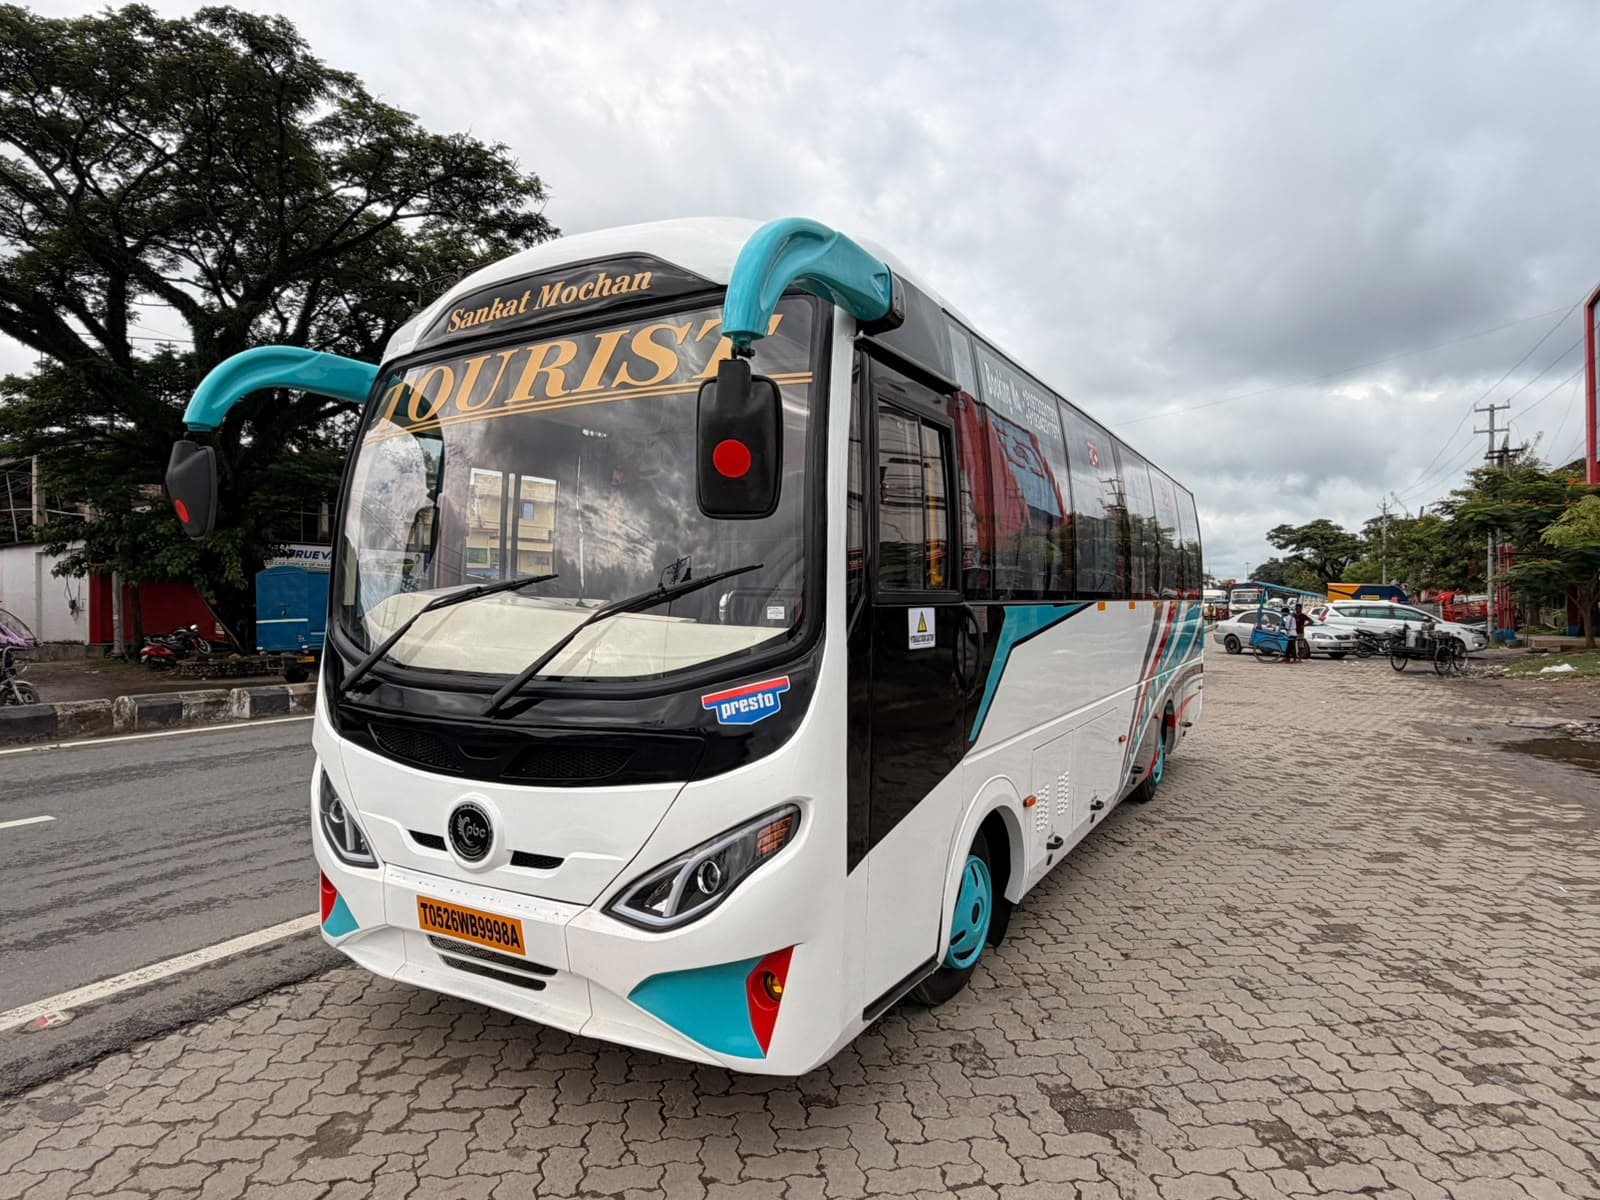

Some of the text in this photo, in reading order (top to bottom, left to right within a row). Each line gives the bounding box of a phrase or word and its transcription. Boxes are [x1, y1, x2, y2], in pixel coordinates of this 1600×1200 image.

[448, 272, 652, 333] Sankat Mochan
[721, 693, 775, 720] presto
